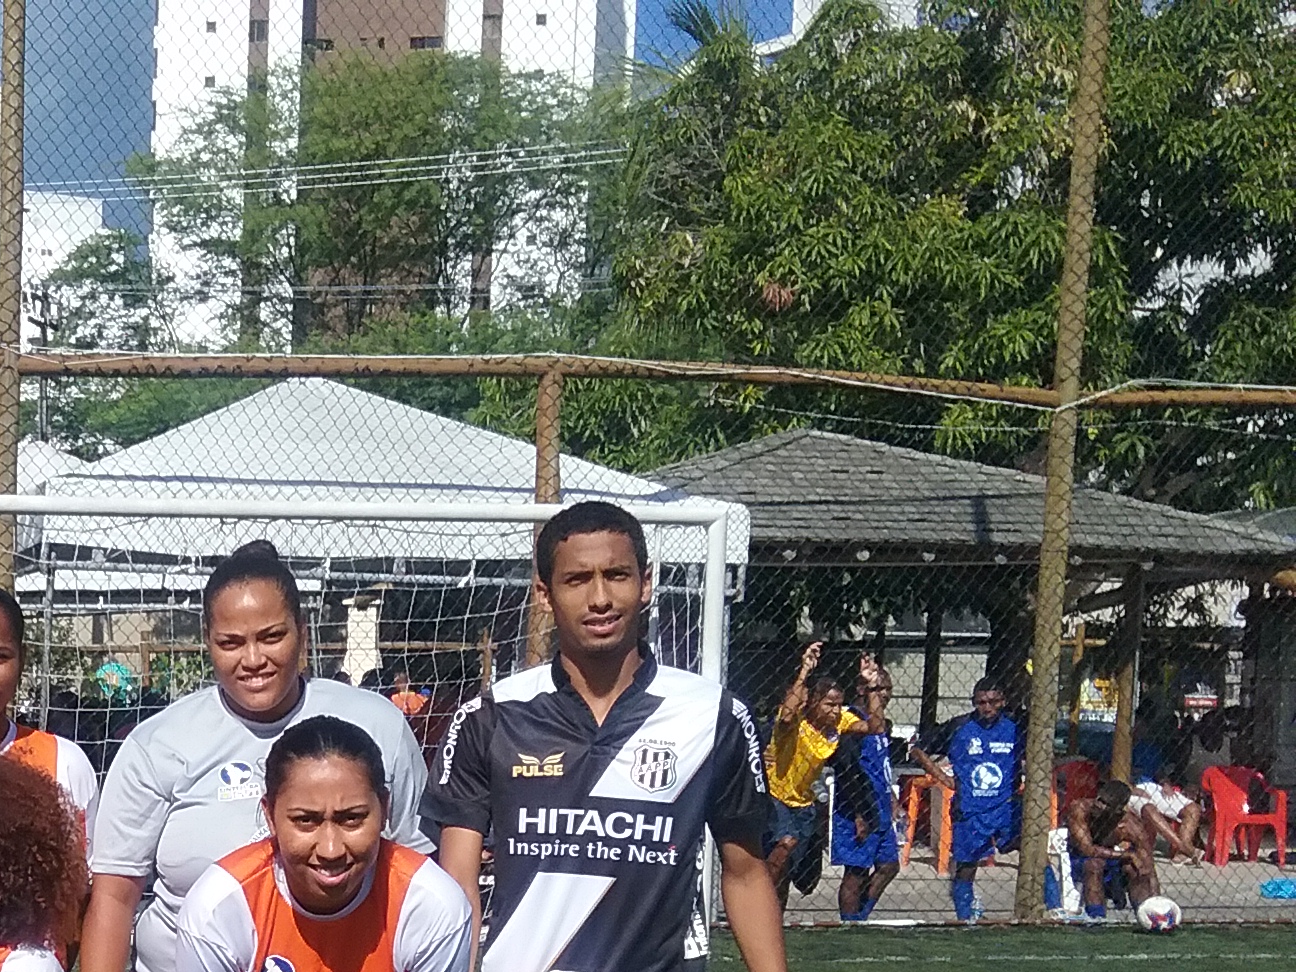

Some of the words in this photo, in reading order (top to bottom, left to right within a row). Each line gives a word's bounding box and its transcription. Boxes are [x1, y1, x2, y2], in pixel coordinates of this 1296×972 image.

[512, 764, 564, 777] PULSE
[518, 807, 673, 843] HITACHI
[508, 838, 580, 860] Inspire
[587, 841, 622, 861] the
[628, 845, 678, 866] Next
